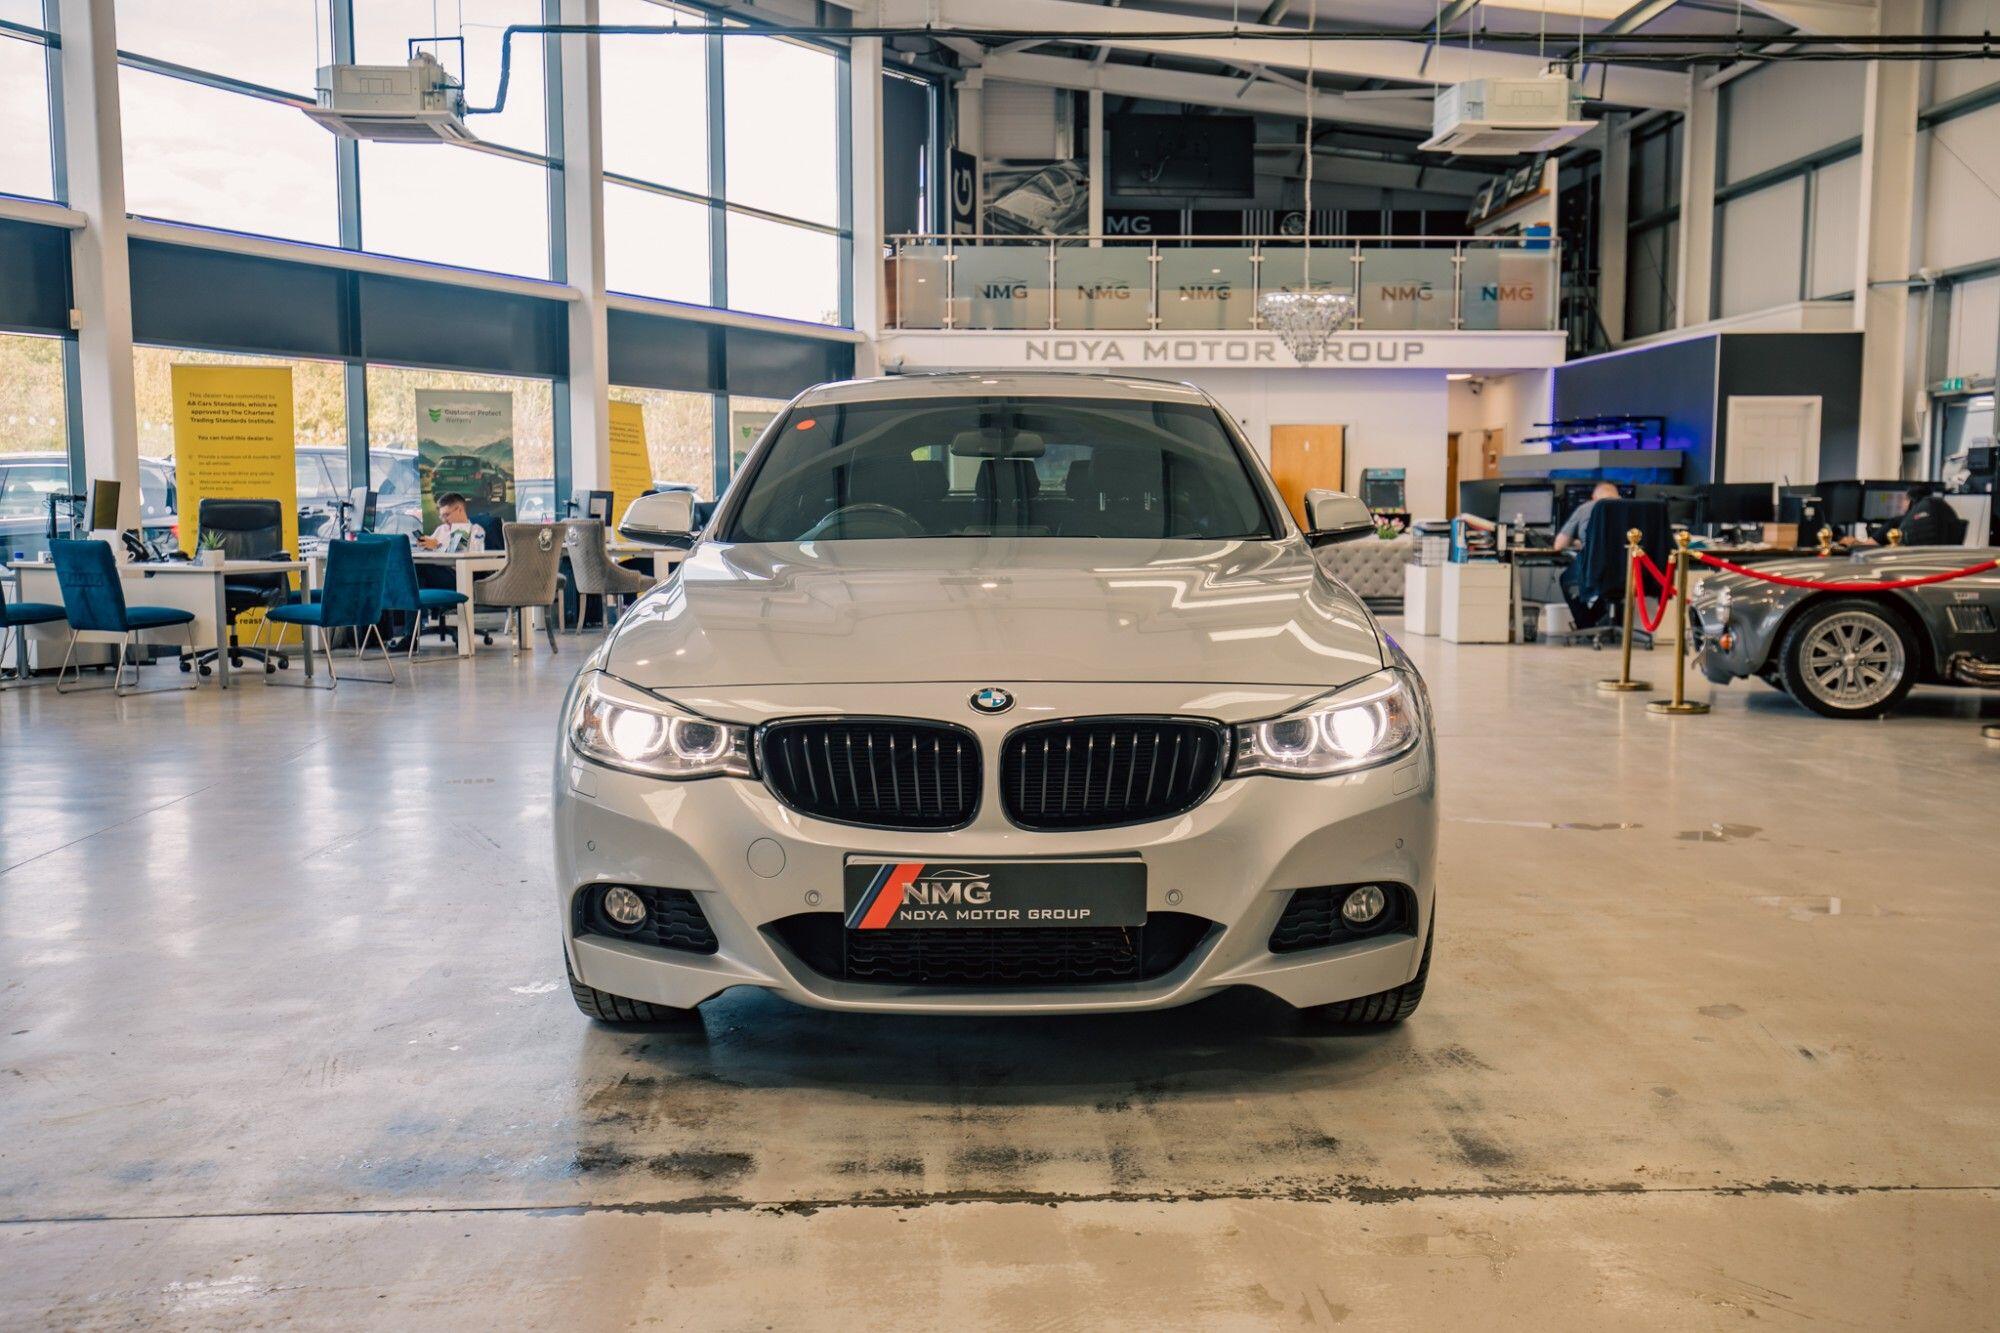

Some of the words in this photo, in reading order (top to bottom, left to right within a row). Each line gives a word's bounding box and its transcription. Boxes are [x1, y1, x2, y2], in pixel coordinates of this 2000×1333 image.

[1106, 216, 1152, 235] MG
[974, 284, 1028, 300] NMG
[1078, 284, 1131, 300] NMG
[1179, 285, 1232, 301] NMG
[1380, 285, 1434, 301] NMG
[1481, 286, 1534, 301] NMG
[1026, 340, 1124, 361] NOYA
[1143, 340, 1275, 362] MOTOR
[1298, 341, 1424, 362] ROUP
[901, 881, 991, 905] NMG
[900, 910, 948, 921] NOYA
[956, 909, 1020, 920] MOTOR
[1028, 909, 1091, 920] GROUP
